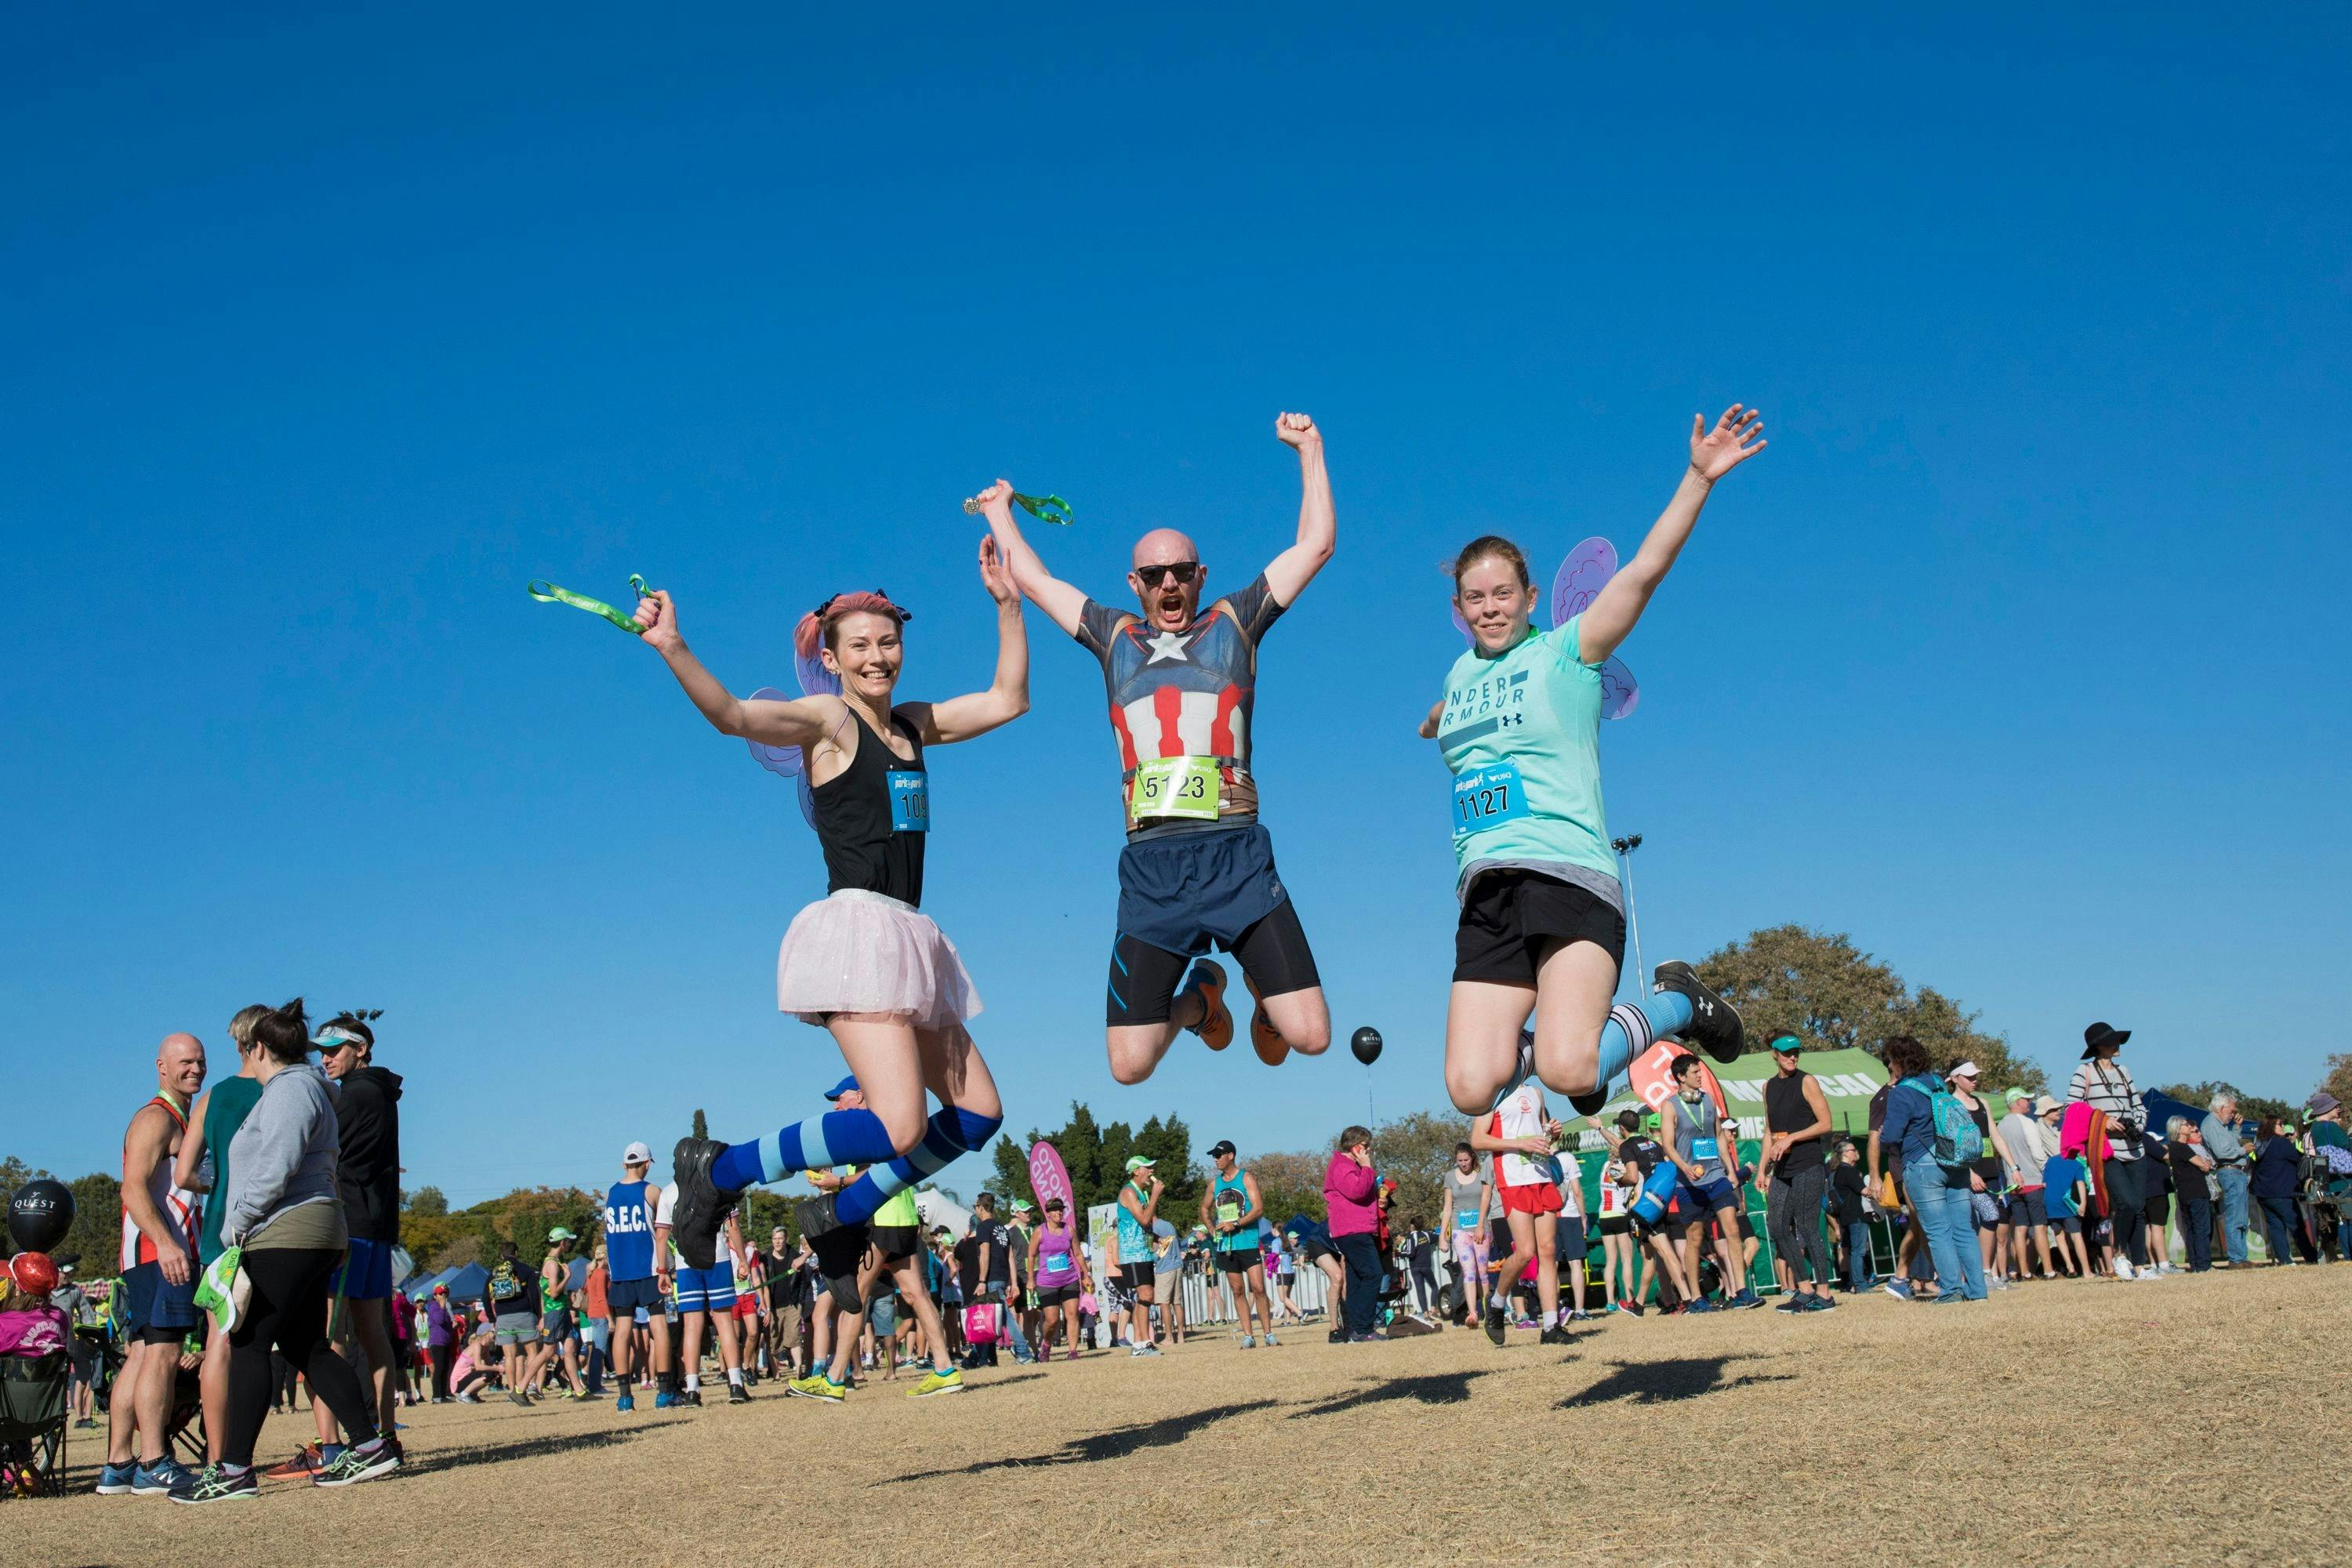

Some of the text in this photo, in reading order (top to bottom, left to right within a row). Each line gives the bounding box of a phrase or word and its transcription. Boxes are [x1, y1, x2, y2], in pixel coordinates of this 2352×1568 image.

[1497, 771, 1512, 781] USQ
[1458, 785, 1509, 822] 1127
[14, 1199, 56, 1209] QUEST
[606, 1205, 647, 1233] S.E.C.
[227, 1254, 238, 1269] USQ
